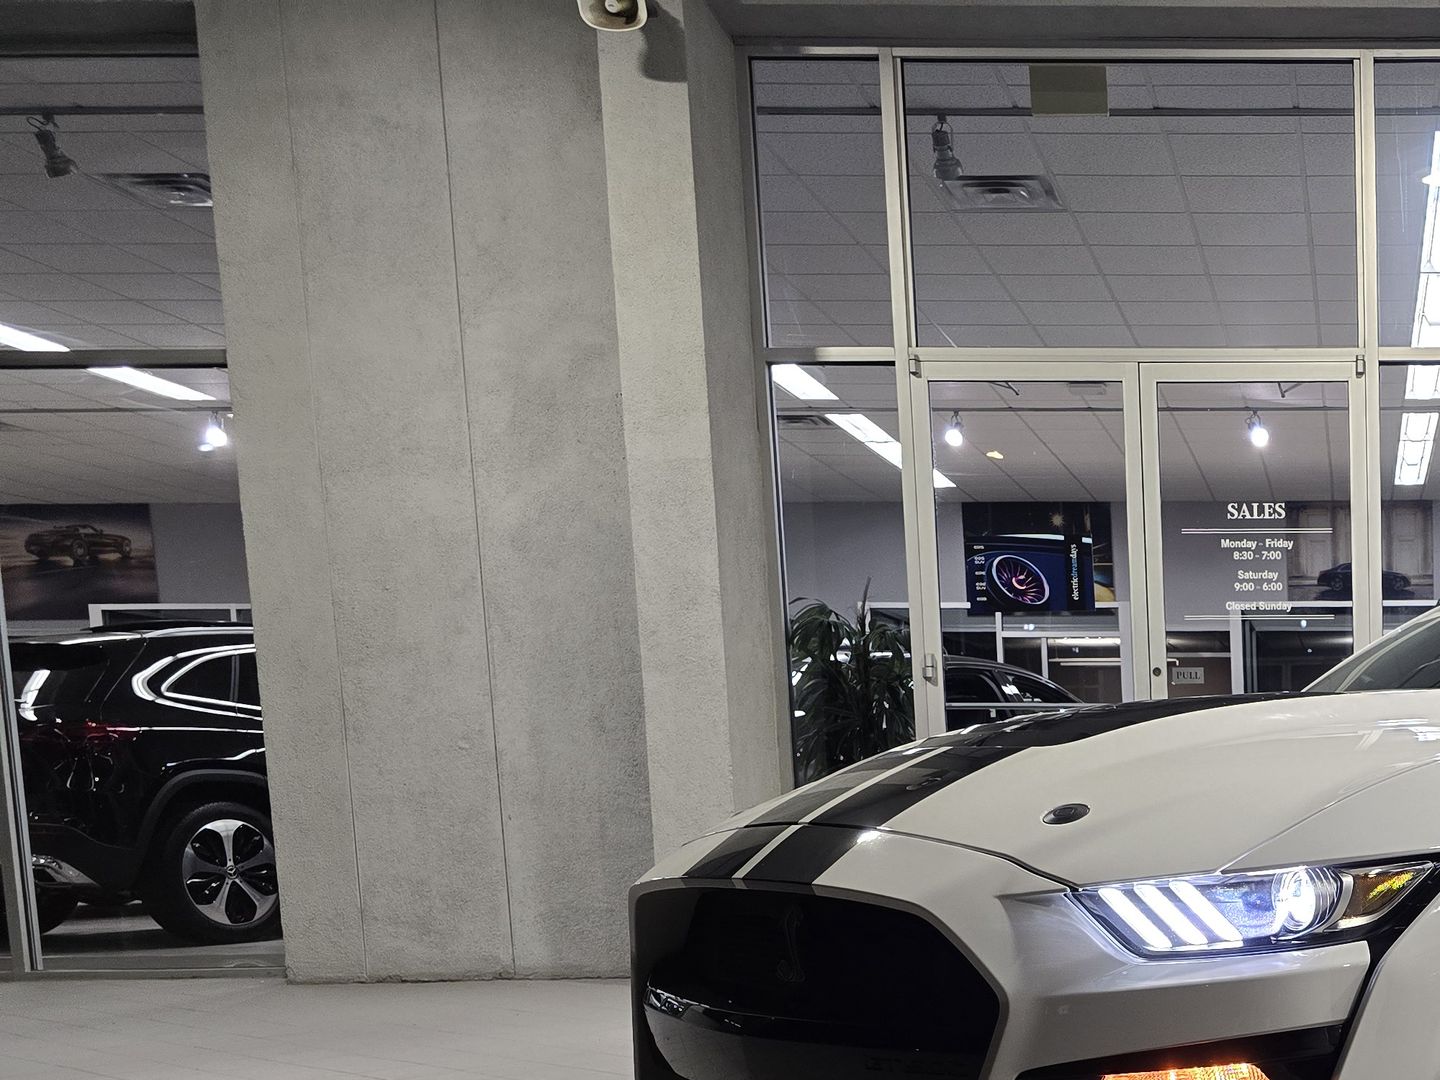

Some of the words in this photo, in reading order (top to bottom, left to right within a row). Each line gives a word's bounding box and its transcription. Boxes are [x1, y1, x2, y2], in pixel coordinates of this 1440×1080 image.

[1227, 502, 1286, 520] SALES
[1221, 539, 1258, 550] Monday
[1265, 538, 1293, 549] Friday
[1233, 551, 1253, 560] 8:30
[1262, 551, 1281, 560] 7:00
[1238, 570, 1278, 581] Saturday
[1234, 583, 1254, 591] 9:00
[1262, 582, 1282, 591] 6:00
[1225, 601, 1257, 611] Closed
[1258, 601, 1292, 612] Sunday
[1176, 671, 1201, 680] PULL
